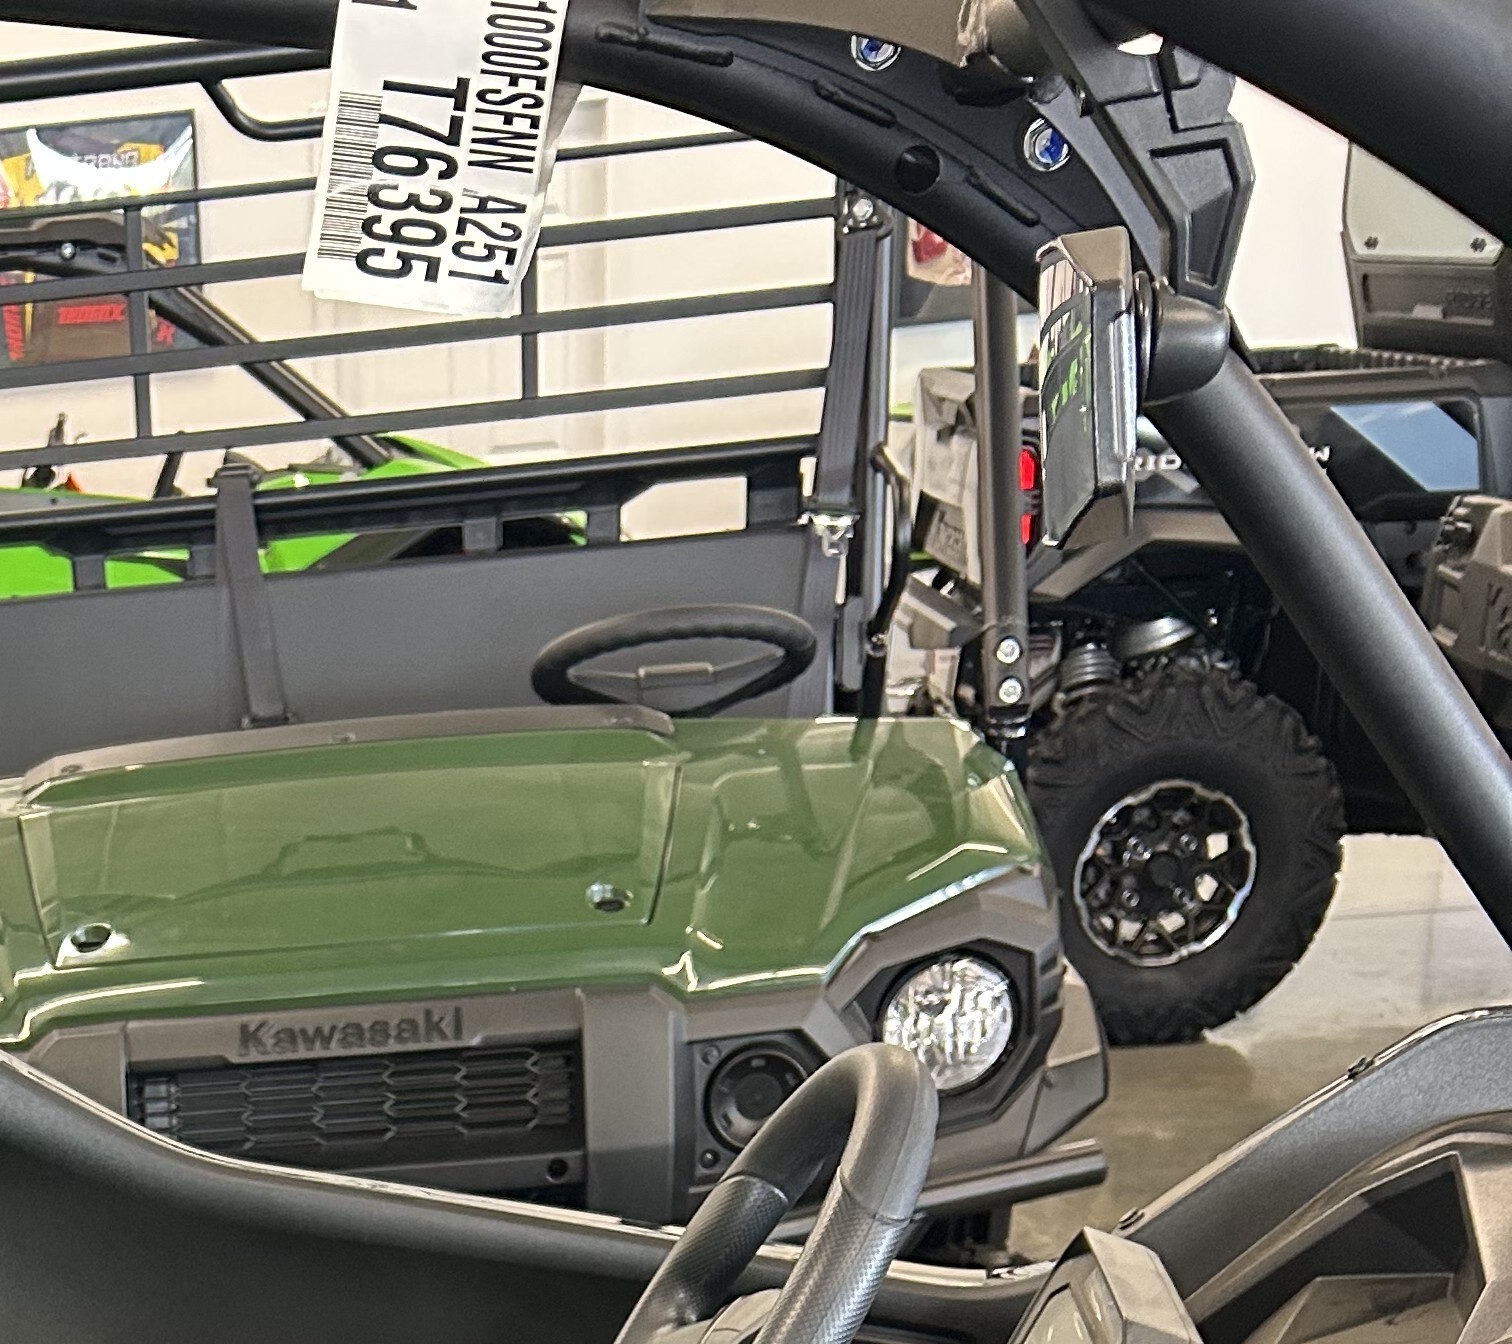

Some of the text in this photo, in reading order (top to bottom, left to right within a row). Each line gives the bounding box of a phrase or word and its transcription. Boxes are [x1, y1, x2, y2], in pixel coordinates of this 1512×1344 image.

[355, 76, 471, 284] T76395
[447, 188, 528, 286] A251
[238, 1006, 464, 1057] Kawasaki
